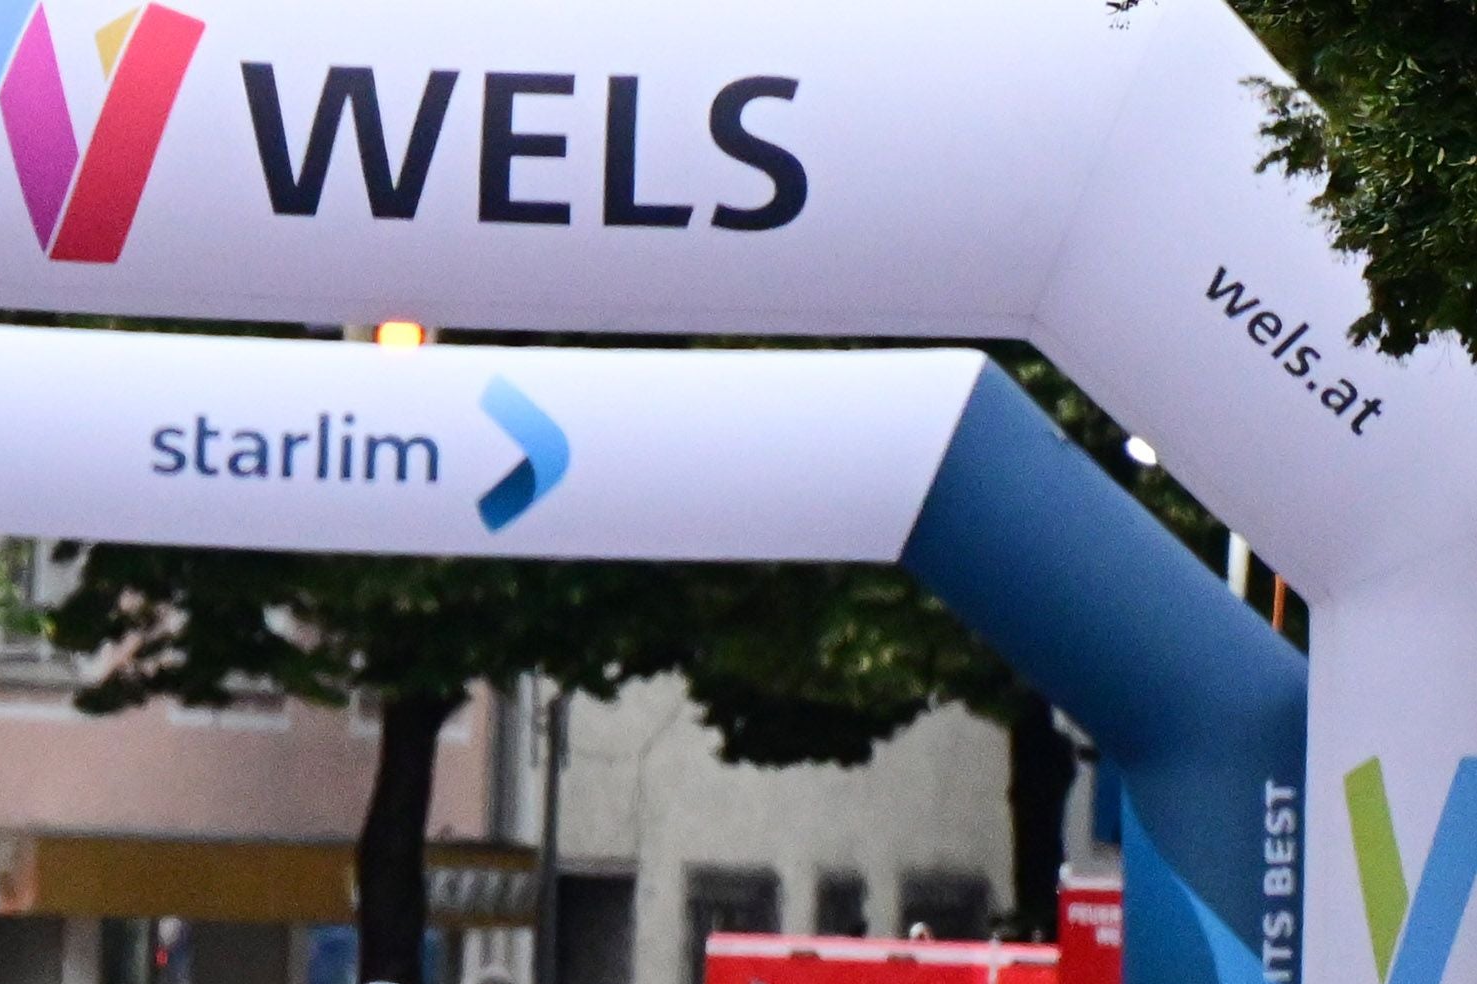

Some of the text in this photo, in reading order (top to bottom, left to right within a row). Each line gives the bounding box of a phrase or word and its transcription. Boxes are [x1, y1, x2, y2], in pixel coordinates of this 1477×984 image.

[239, 60, 809, 232] WELS
[1205, 264, 1384, 437] wels.at
[150, 412, 439, 483] starlim
[1263, 779, 1299, 898] BEST
[1261, 910, 1296, 983] ITS
